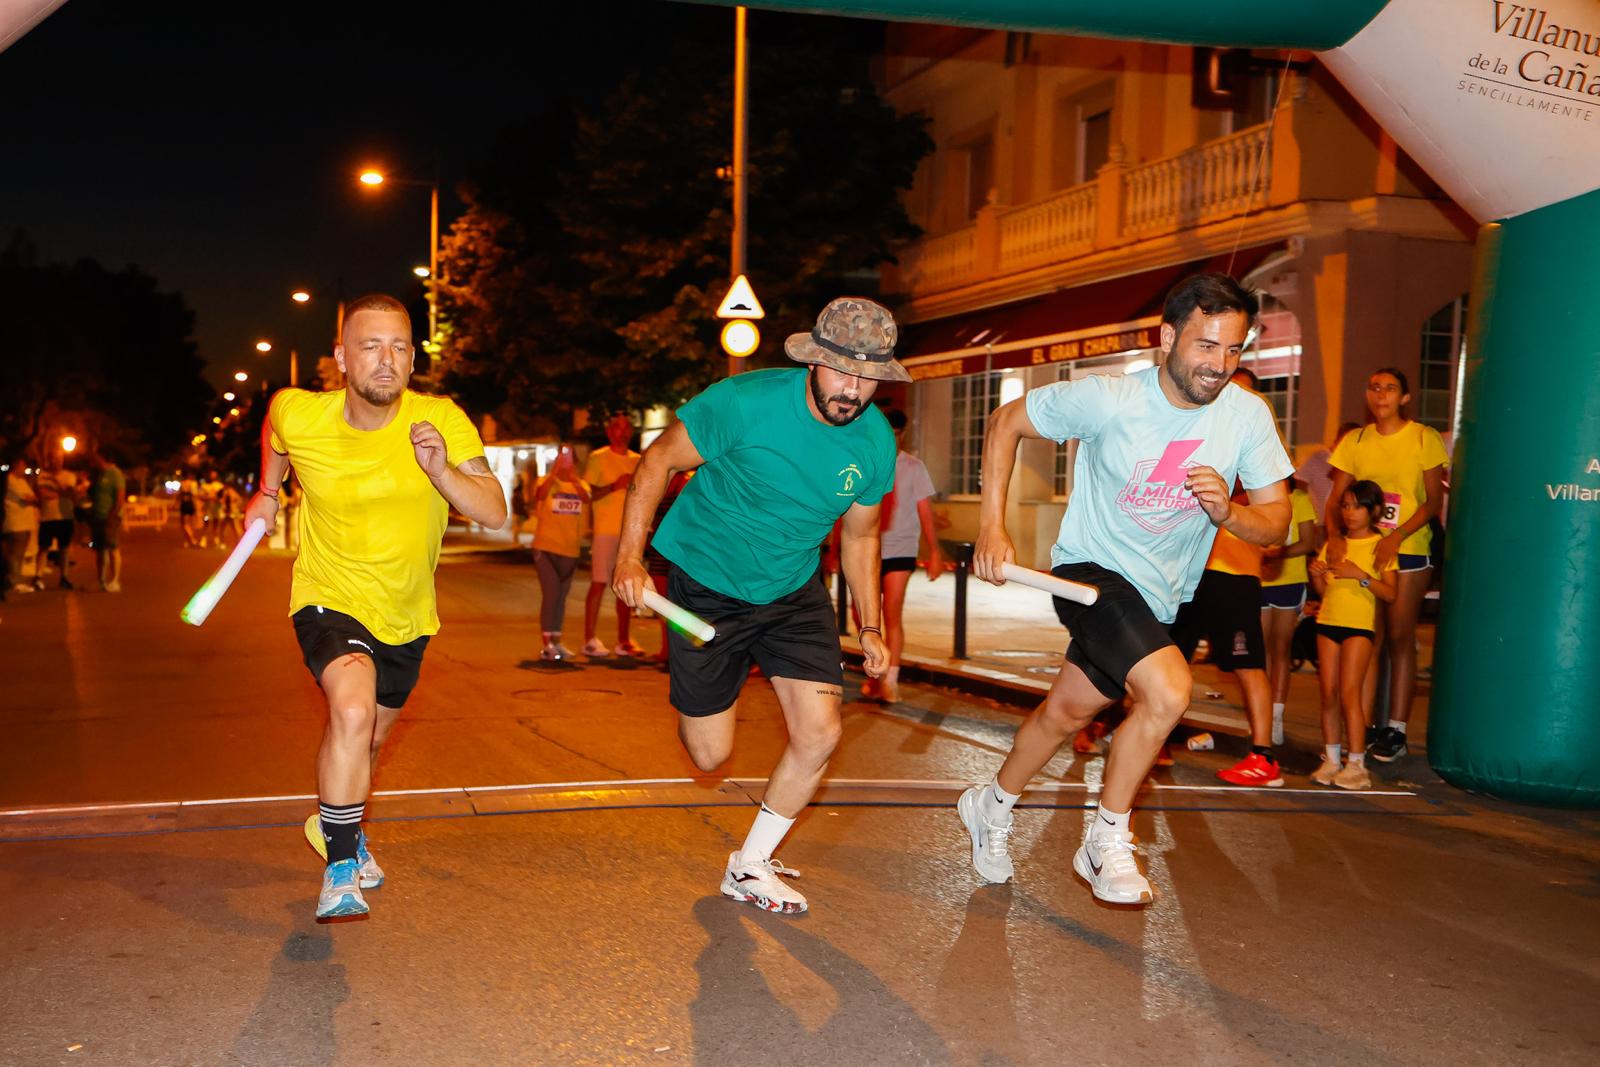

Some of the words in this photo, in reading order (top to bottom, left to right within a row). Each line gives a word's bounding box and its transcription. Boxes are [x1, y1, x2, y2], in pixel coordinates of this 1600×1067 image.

[1468, 53, 1490, 71] de
[1493, 57, 1508, 75] la
[1457, 80, 1593, 121] SENCILLAMENTE
[1032, 348, 1045, 363] EL
[1585, 458, 1600, 474] A
[1143, 486, 1193, 501] MILL
[1124, 494, 1197, 510] NOCTURN
